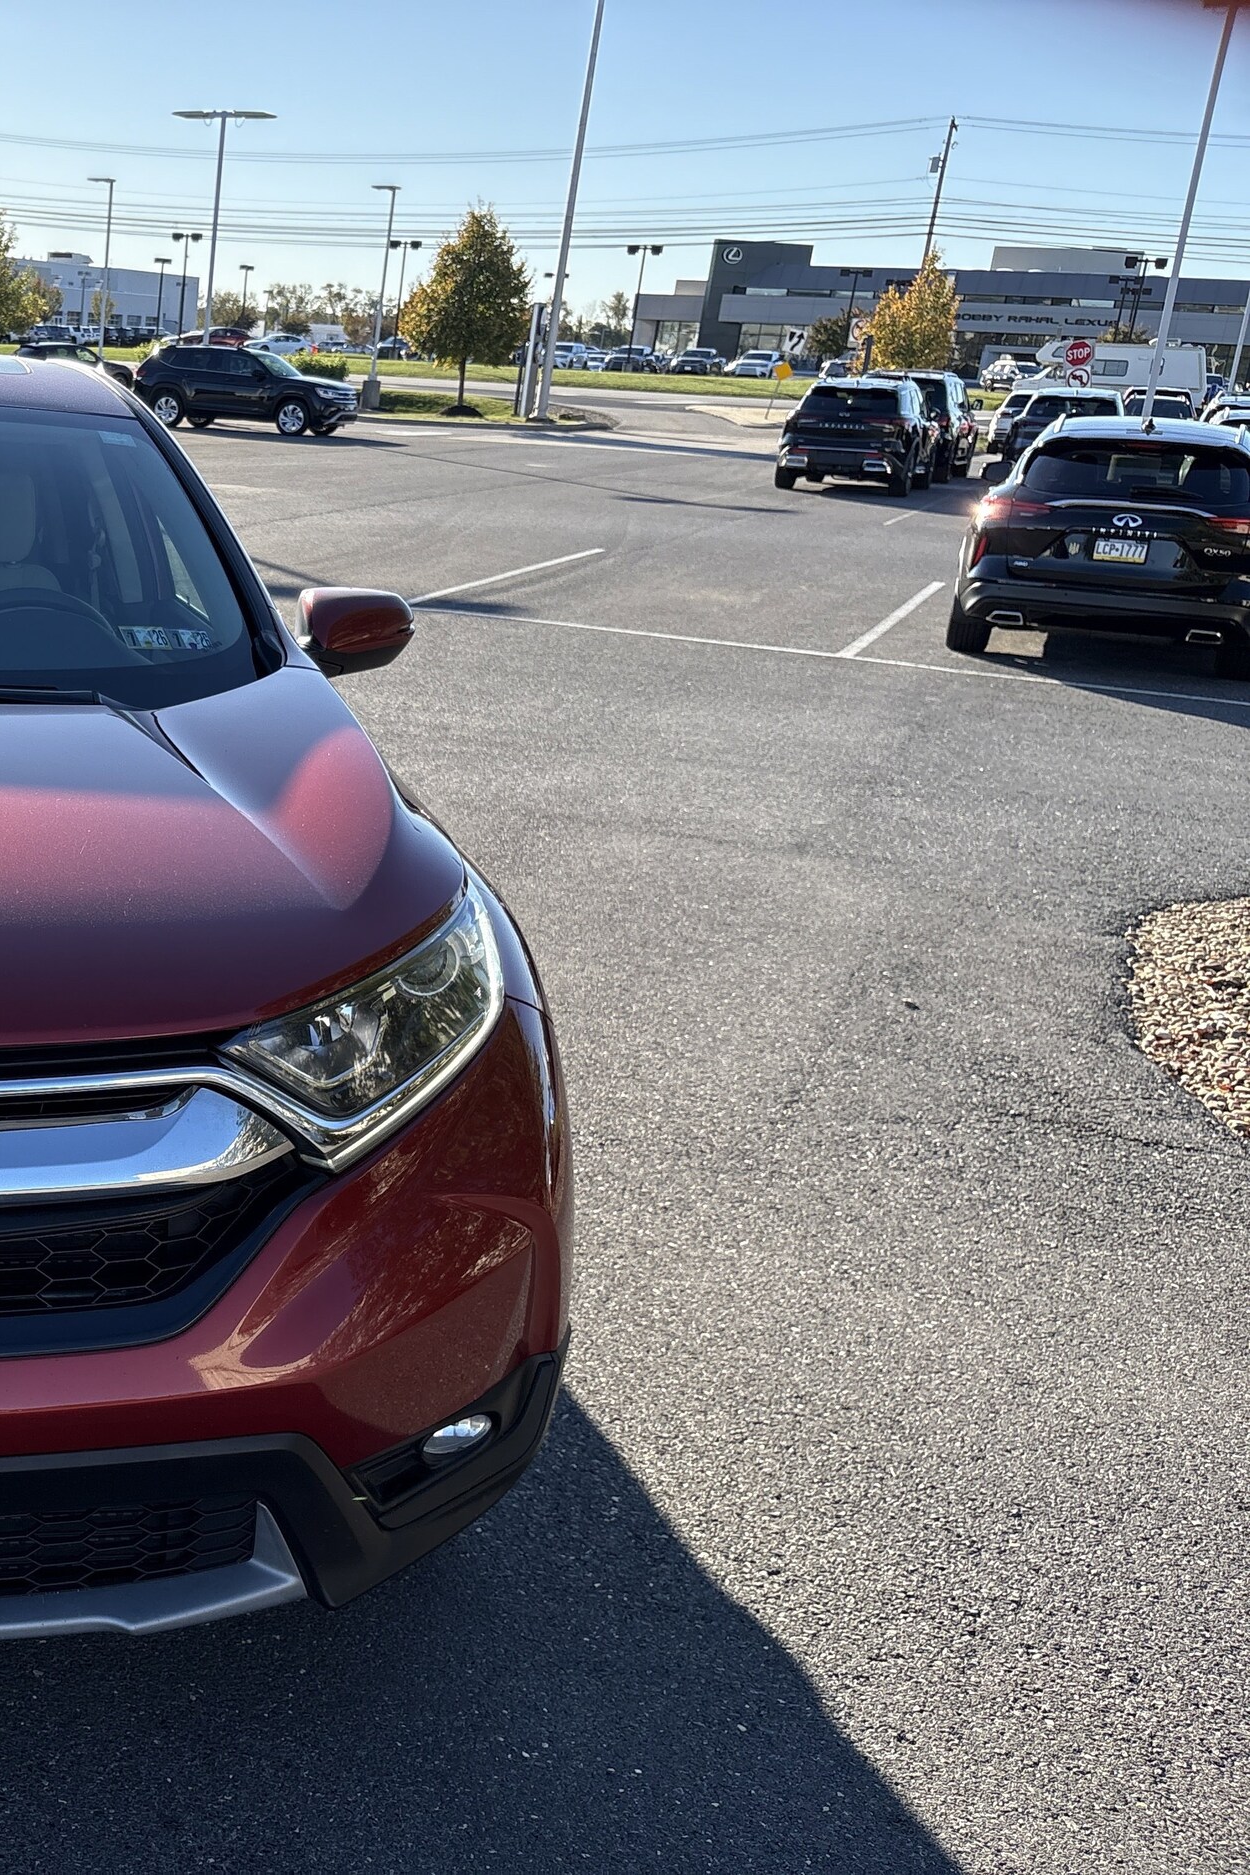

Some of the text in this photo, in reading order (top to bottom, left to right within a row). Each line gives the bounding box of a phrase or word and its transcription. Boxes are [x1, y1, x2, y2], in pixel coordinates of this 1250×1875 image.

[1007, 315, 1060, 325] RAHAL
[1066, 346, 1091, 361] STOP
[1092, 526, 1158, 539] INFINITI
